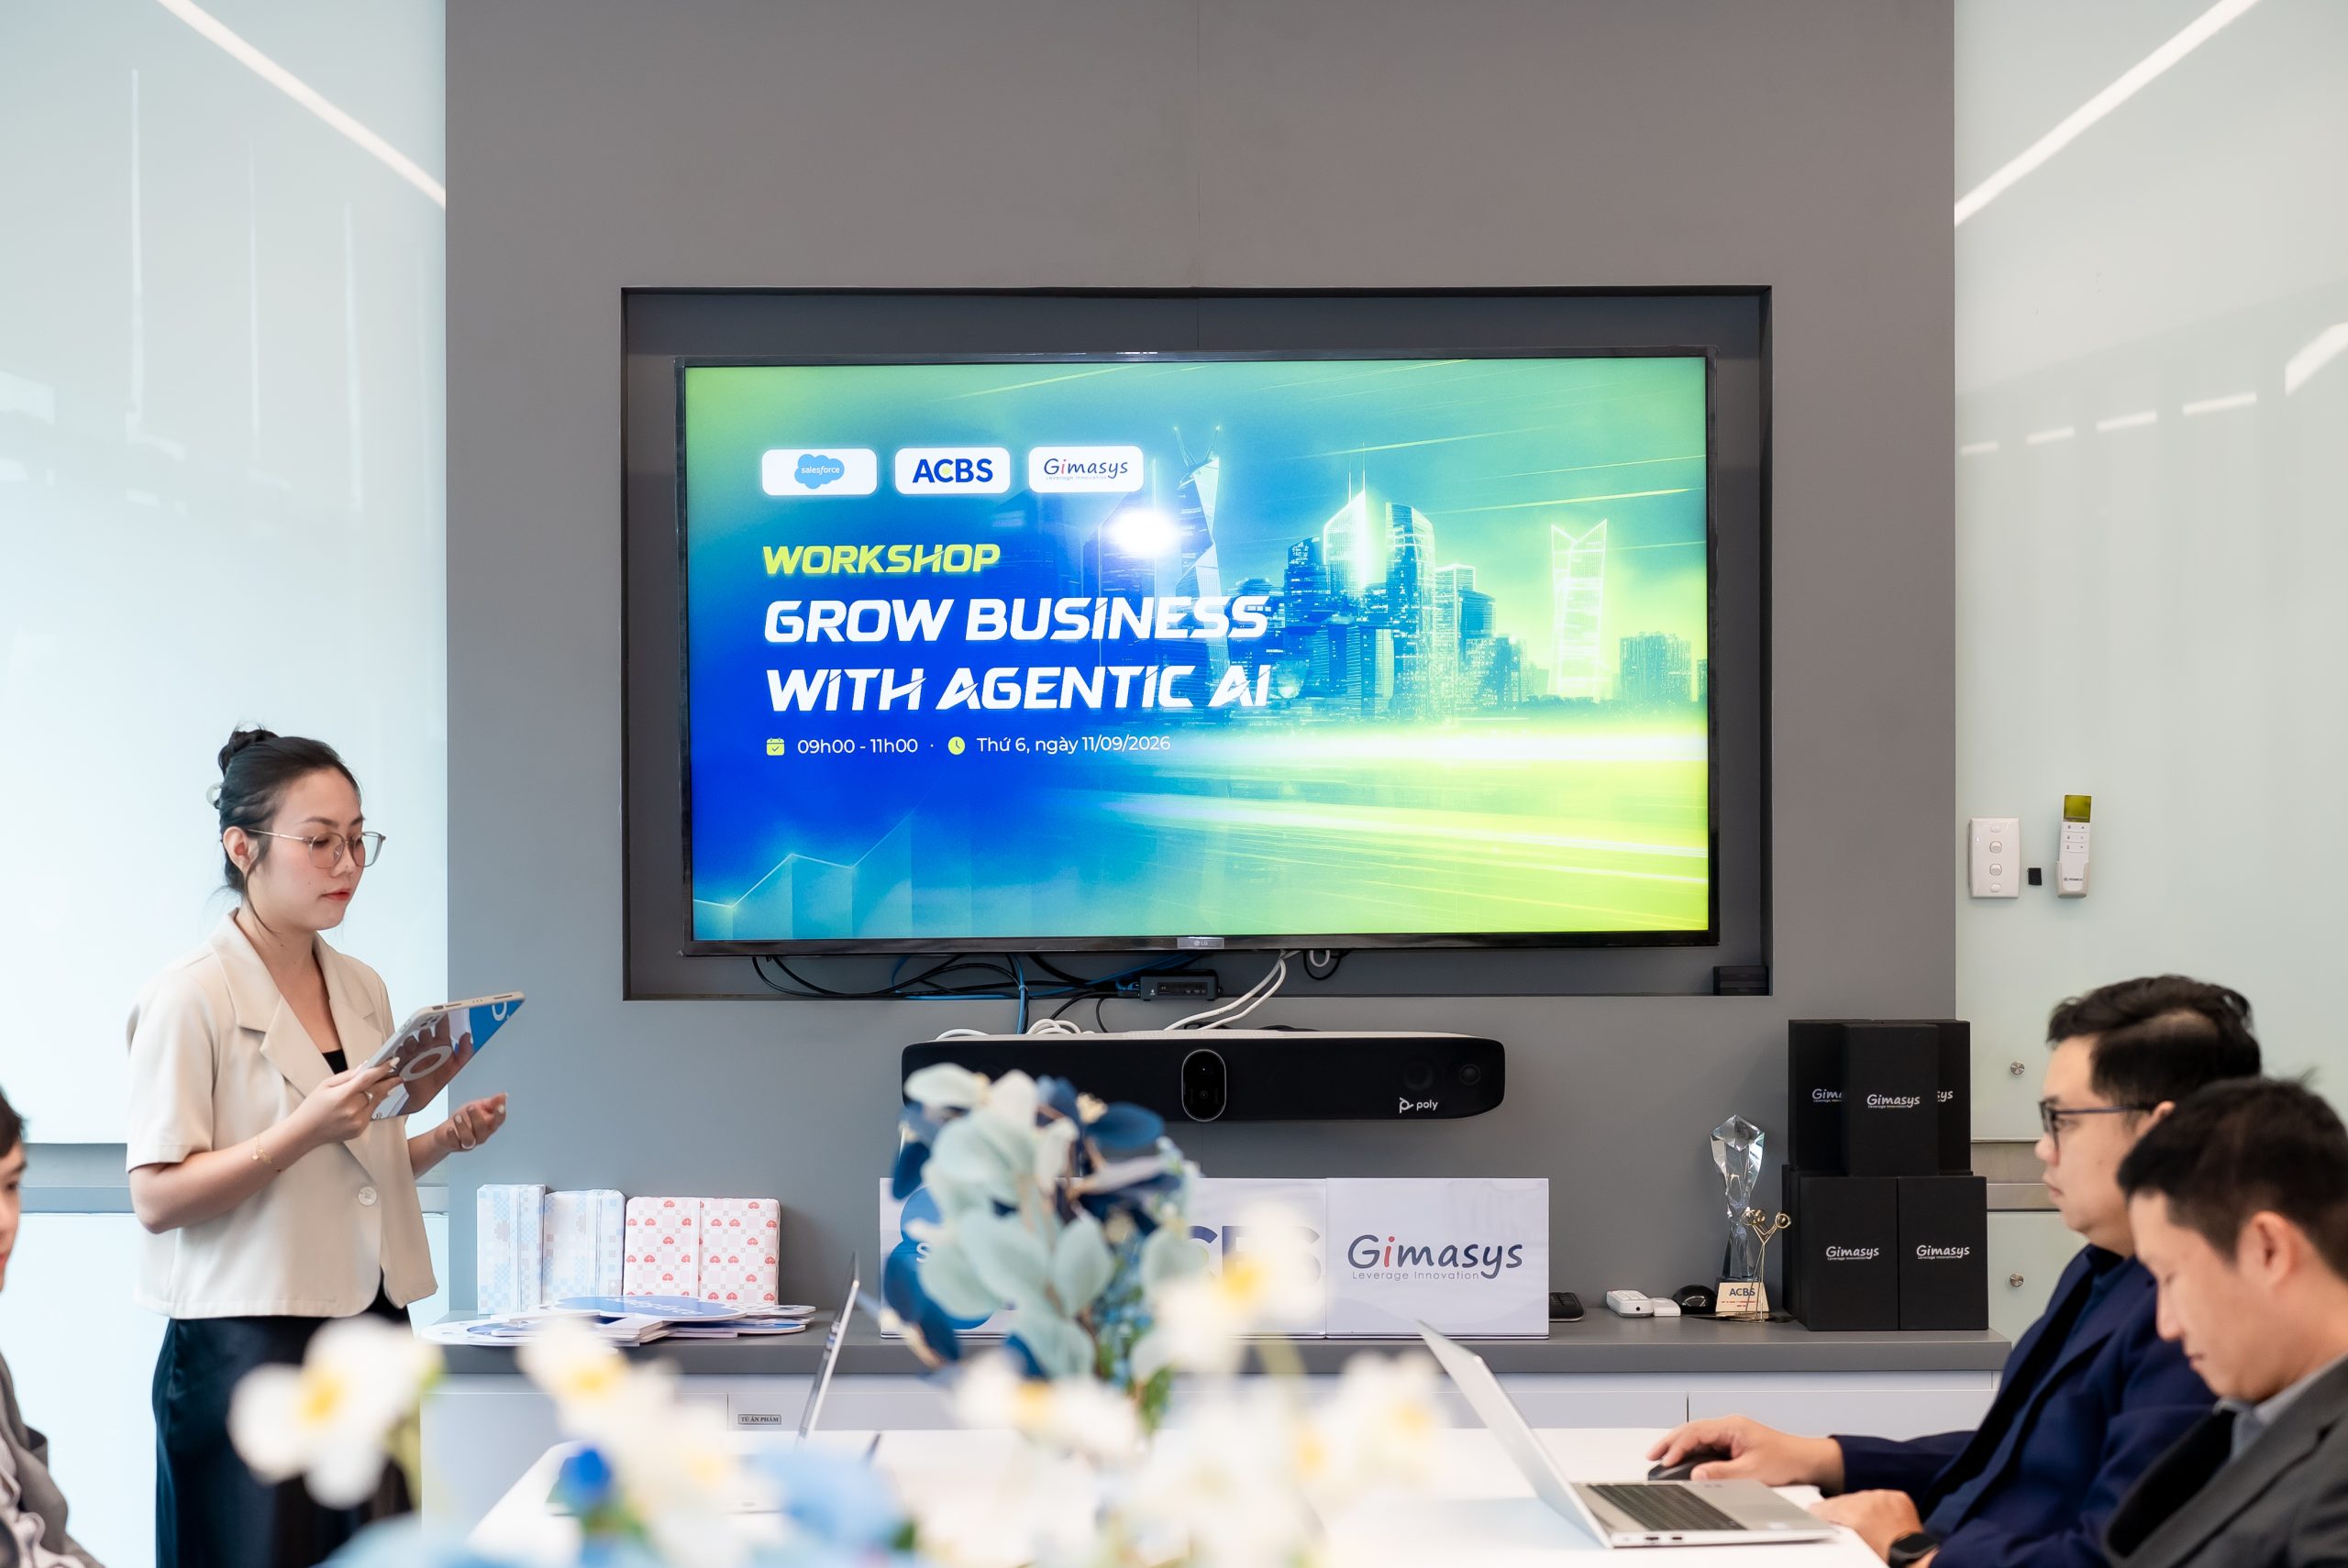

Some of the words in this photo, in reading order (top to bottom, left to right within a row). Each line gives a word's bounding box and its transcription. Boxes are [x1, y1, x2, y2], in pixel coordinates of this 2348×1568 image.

[801, 466, 840, 475] salesforce
[913, 458, 993, 483] ACBS
[1044, 458, 1128, 479] Gimasys
[763, 544, 1001, 574] WORKSHOP
[764, 599, 955, 643] GROW
[966, 596, 1269, 641] BUSINESS
[766, 668, 927, 712] WITH
[936, 665, 1196, 710] AGENTIC
[1207, 665, 1272, 707] AI
[797, 738, 856, 755] 09h00
[869, 738, 918, 754] 11h00
[977, 736, 1011, 752] Thứ
[1015, 737, 1030, 754] 6,
[1035, 736, 1079, 755] ngày
[1081, 734, 1171, 753] 11/09/2026
[1416, 1099, 1438, 1111] poly
[1866, 1094, 1921, 1109] Gimasys
[1347, 1234, 1523, 1279] Gimasys
[1825, 1246, 1879, 1259] Gimasys
[1916, 1244, 1970, 1258] Gimasys
[1352, 1271, 1409, 1281] Leverage
[1414, 1271, 1479, 1280] Innovation
[1729, 1287, 1755, 1297] ACBS
